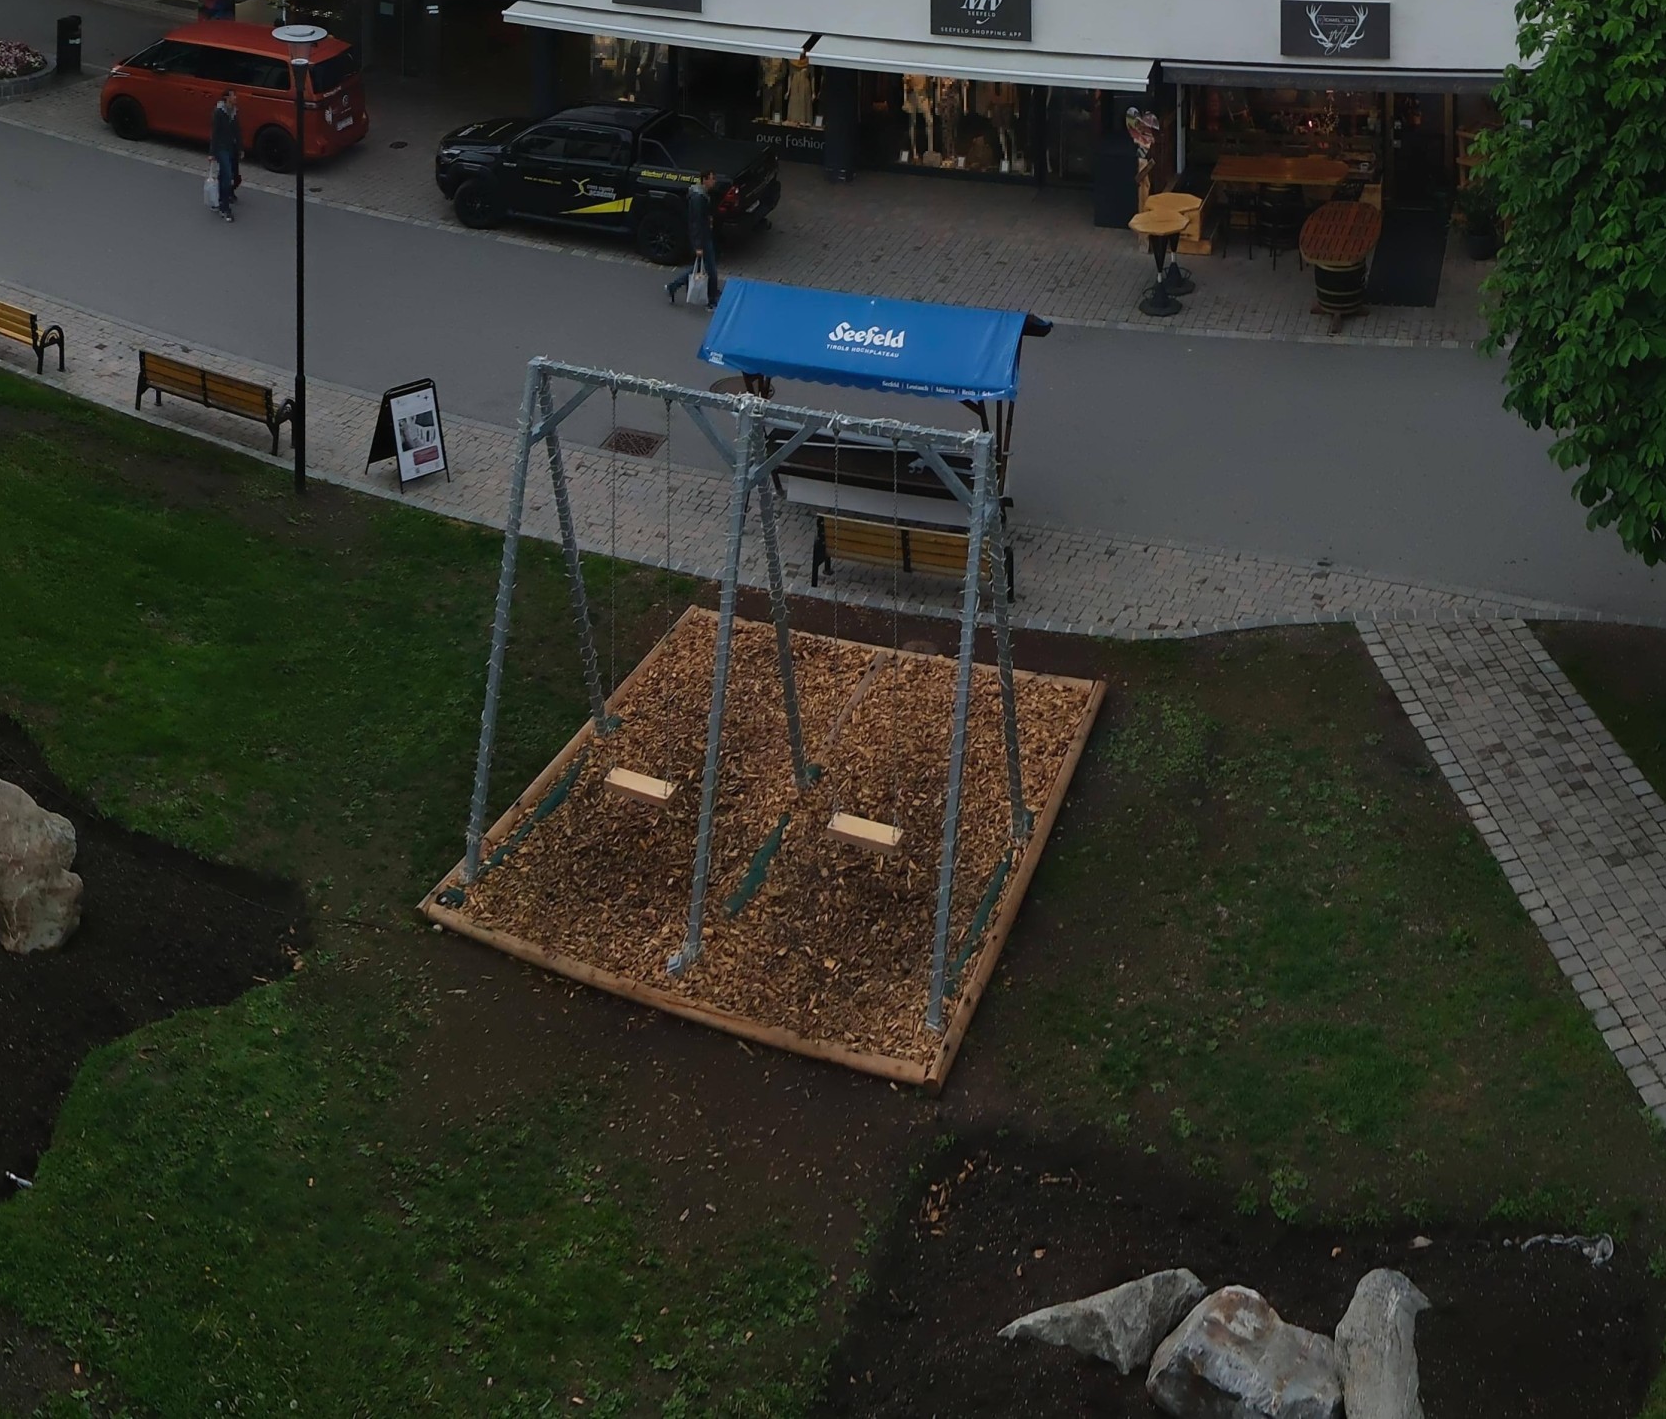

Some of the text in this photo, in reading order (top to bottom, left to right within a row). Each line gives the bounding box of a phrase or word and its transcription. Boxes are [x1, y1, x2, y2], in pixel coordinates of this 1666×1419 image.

[967, 10, 996, 18] SEEFELD
[940, 26, 969, 34] SEEFELD
[971, 28, 1007, 37] SHOPPING
[829, 322, 906, 348] Seefeld
[826, 344, 900, 359] TIROLS HOCHPLATEAU
